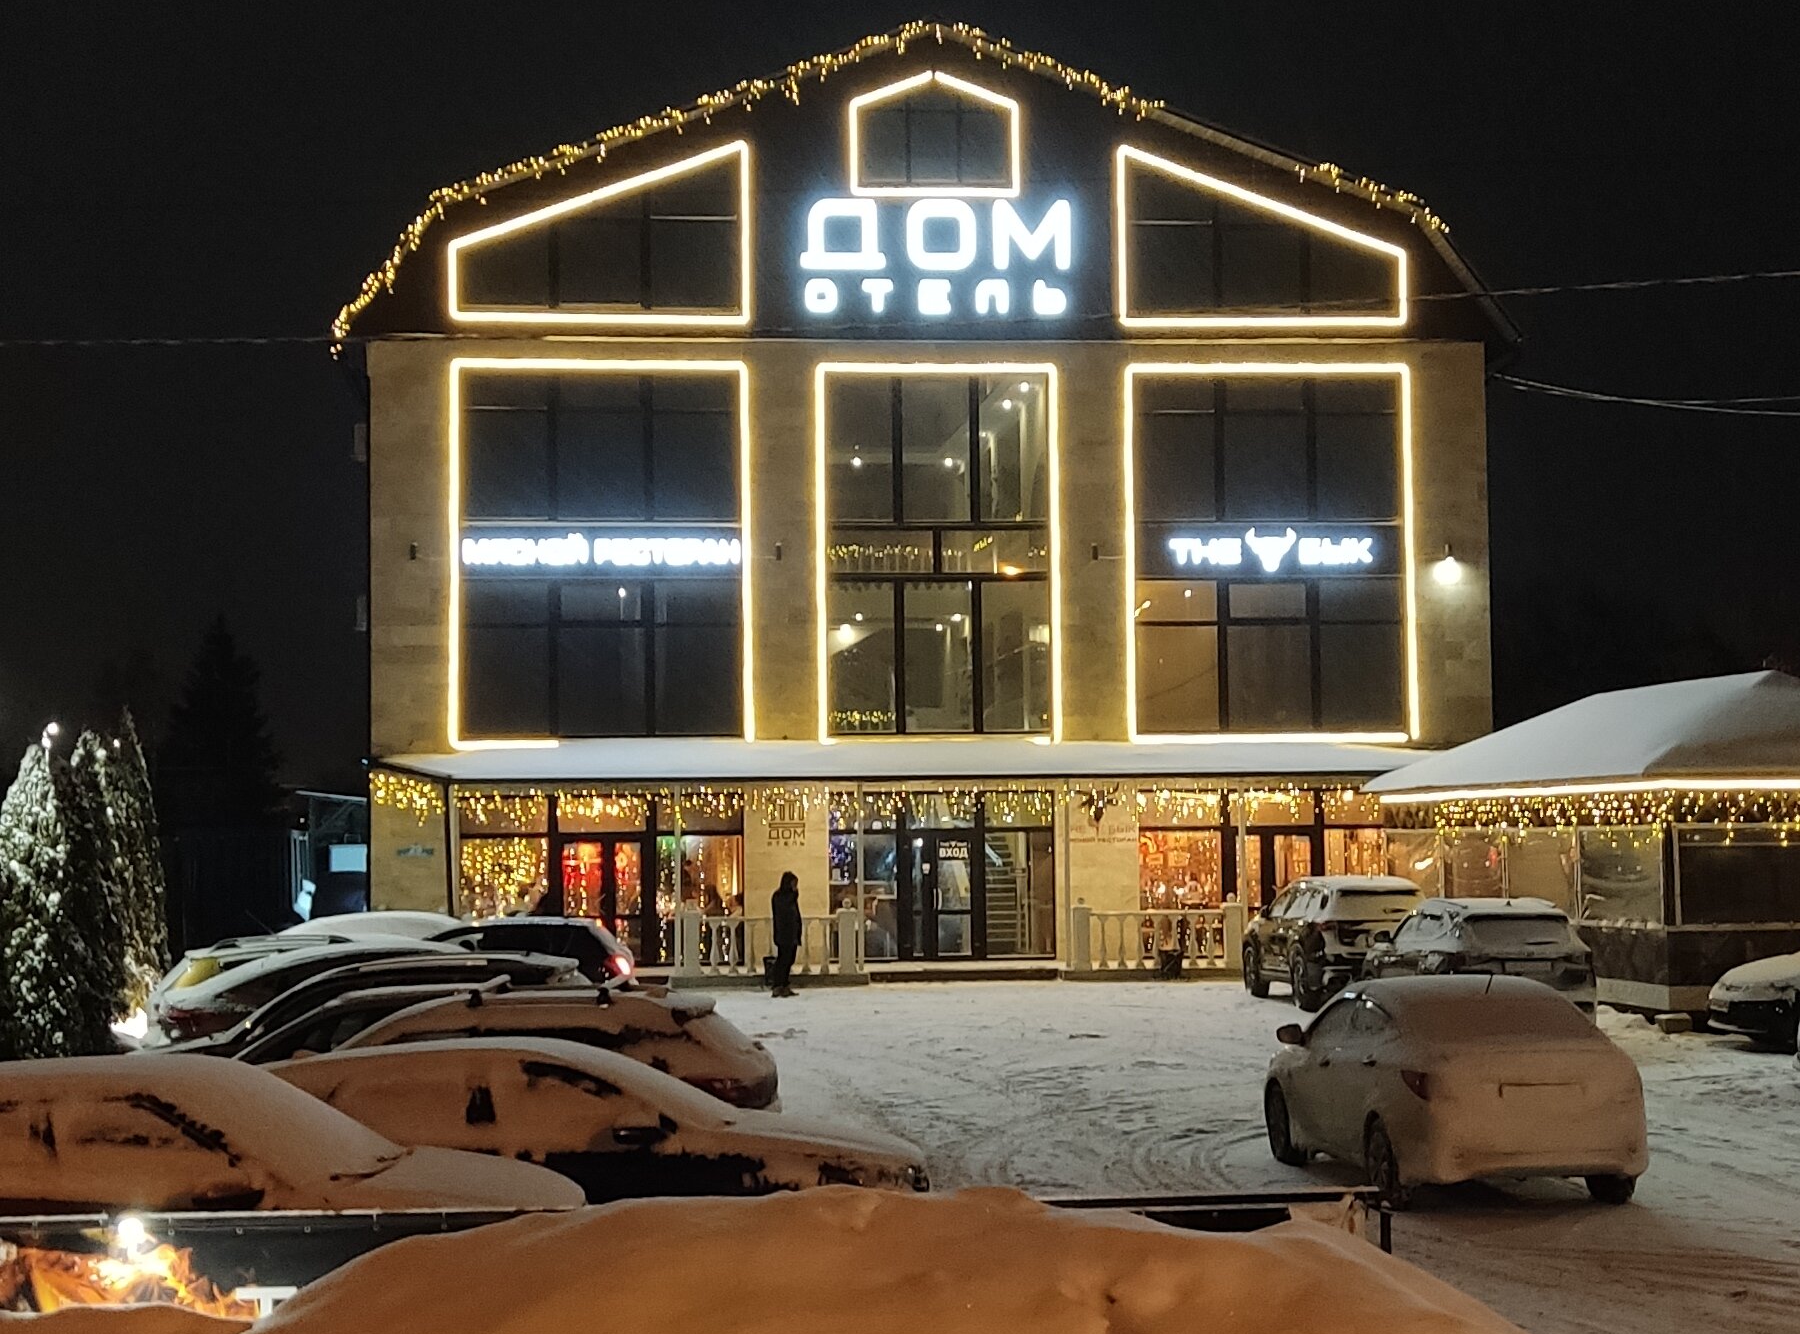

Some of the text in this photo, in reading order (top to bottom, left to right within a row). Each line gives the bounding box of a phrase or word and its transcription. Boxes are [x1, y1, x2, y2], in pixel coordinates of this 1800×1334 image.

[800, 198, 1071, 270] ДОМ
[804, 278, 1067, 315] ОТЕЛЬ
[1169, 538, 1242, 565] THE
[768, 828, 806, 840] ДОМ
[939, 847, 969, 859] ВХОД
